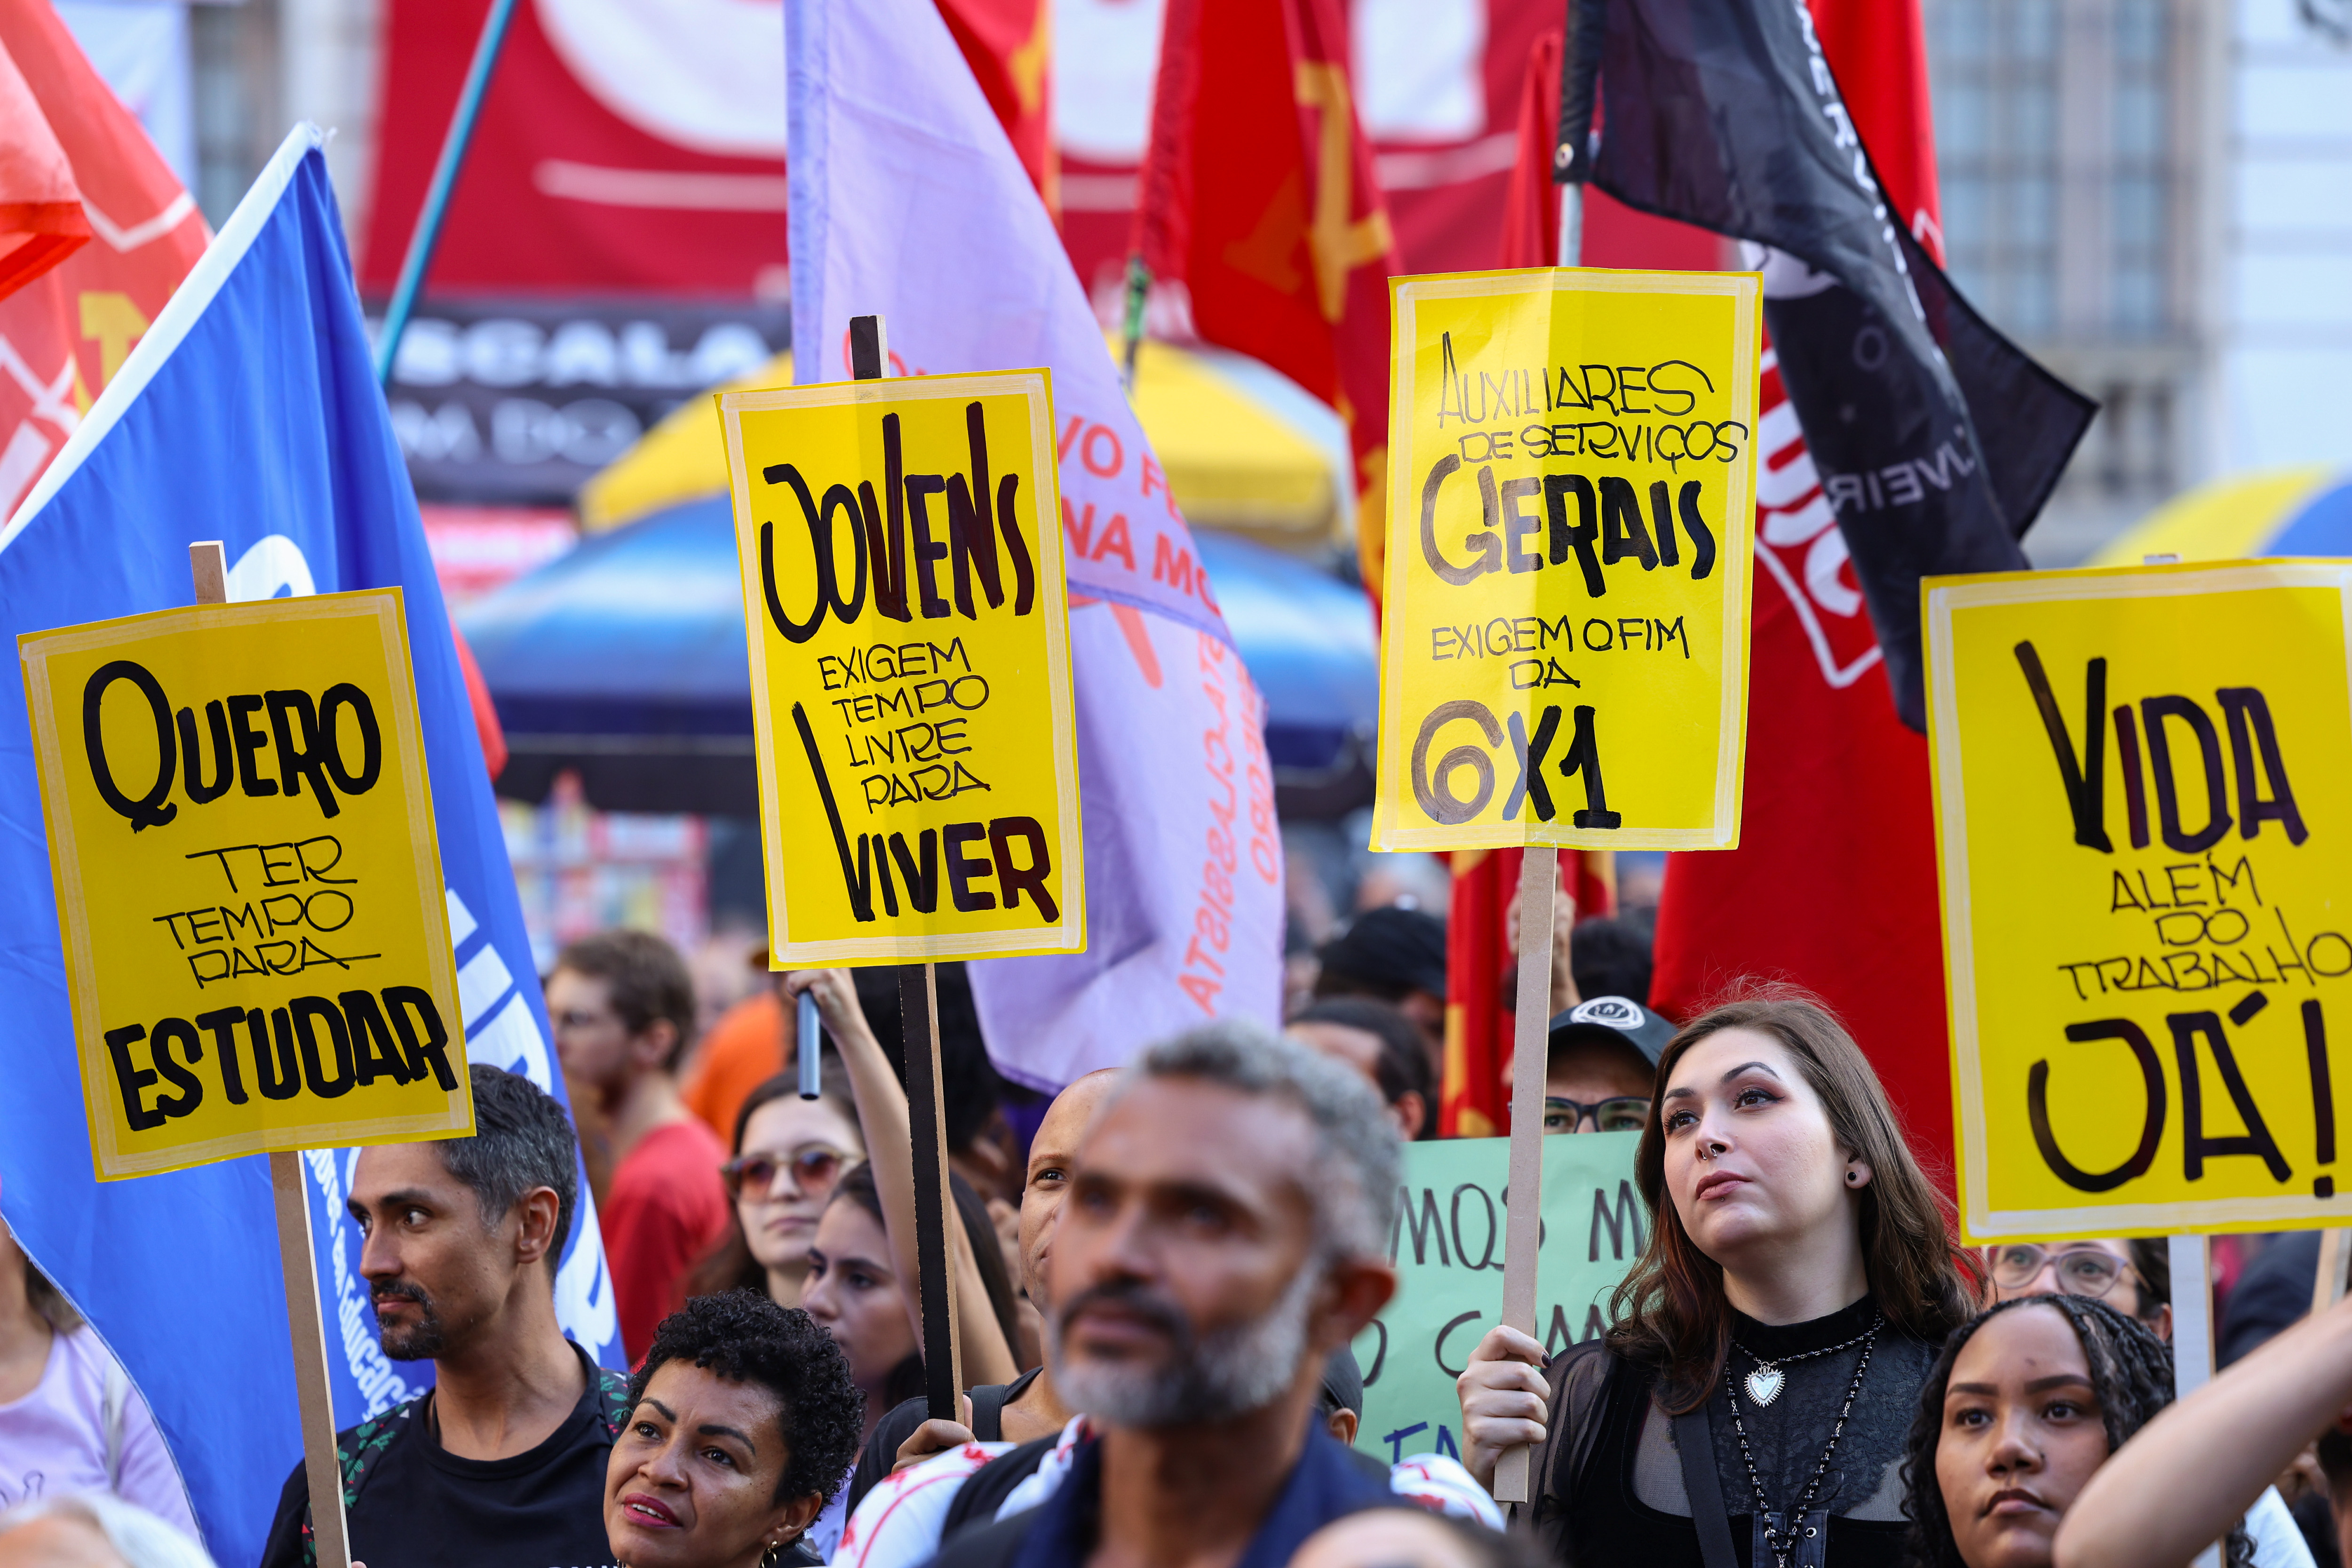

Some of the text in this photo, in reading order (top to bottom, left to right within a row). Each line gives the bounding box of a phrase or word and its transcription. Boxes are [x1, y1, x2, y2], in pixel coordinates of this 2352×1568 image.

[1438, 332, 1714, 428] AUXILIARES
[1458, 420, 1748, 474] DE SERVIÇOS
[761, 401, 1035, 644] JOVENS
[1420, 454, 1716, 598] GERAIS
[818, 637, 971, 691] EXIGEM
[1432, 615, 1690, 660] EXIGEM O FIM
[832, 675, 990, 728] TEMPO
[1510, 657, 1581, 690] DA
[83, 661, 381, 833] QUERO
[846, 717, 972, 768] LIVRE
[2014, 640, 2309, 853] VIDA
[791, 701, 1060, 924] VIVER
[861, 761, 991, 814] PARA
[187, 835, 358, 892] TER
[153, 890, 354, 949] TEMPO
[2155, 909, 2249, 946] DO
[188, 937, 381, 988] PARA
[2058, 906, 2352, 1000] TRABALHO
[104, 986, 459, 1131] ESTUDAR
